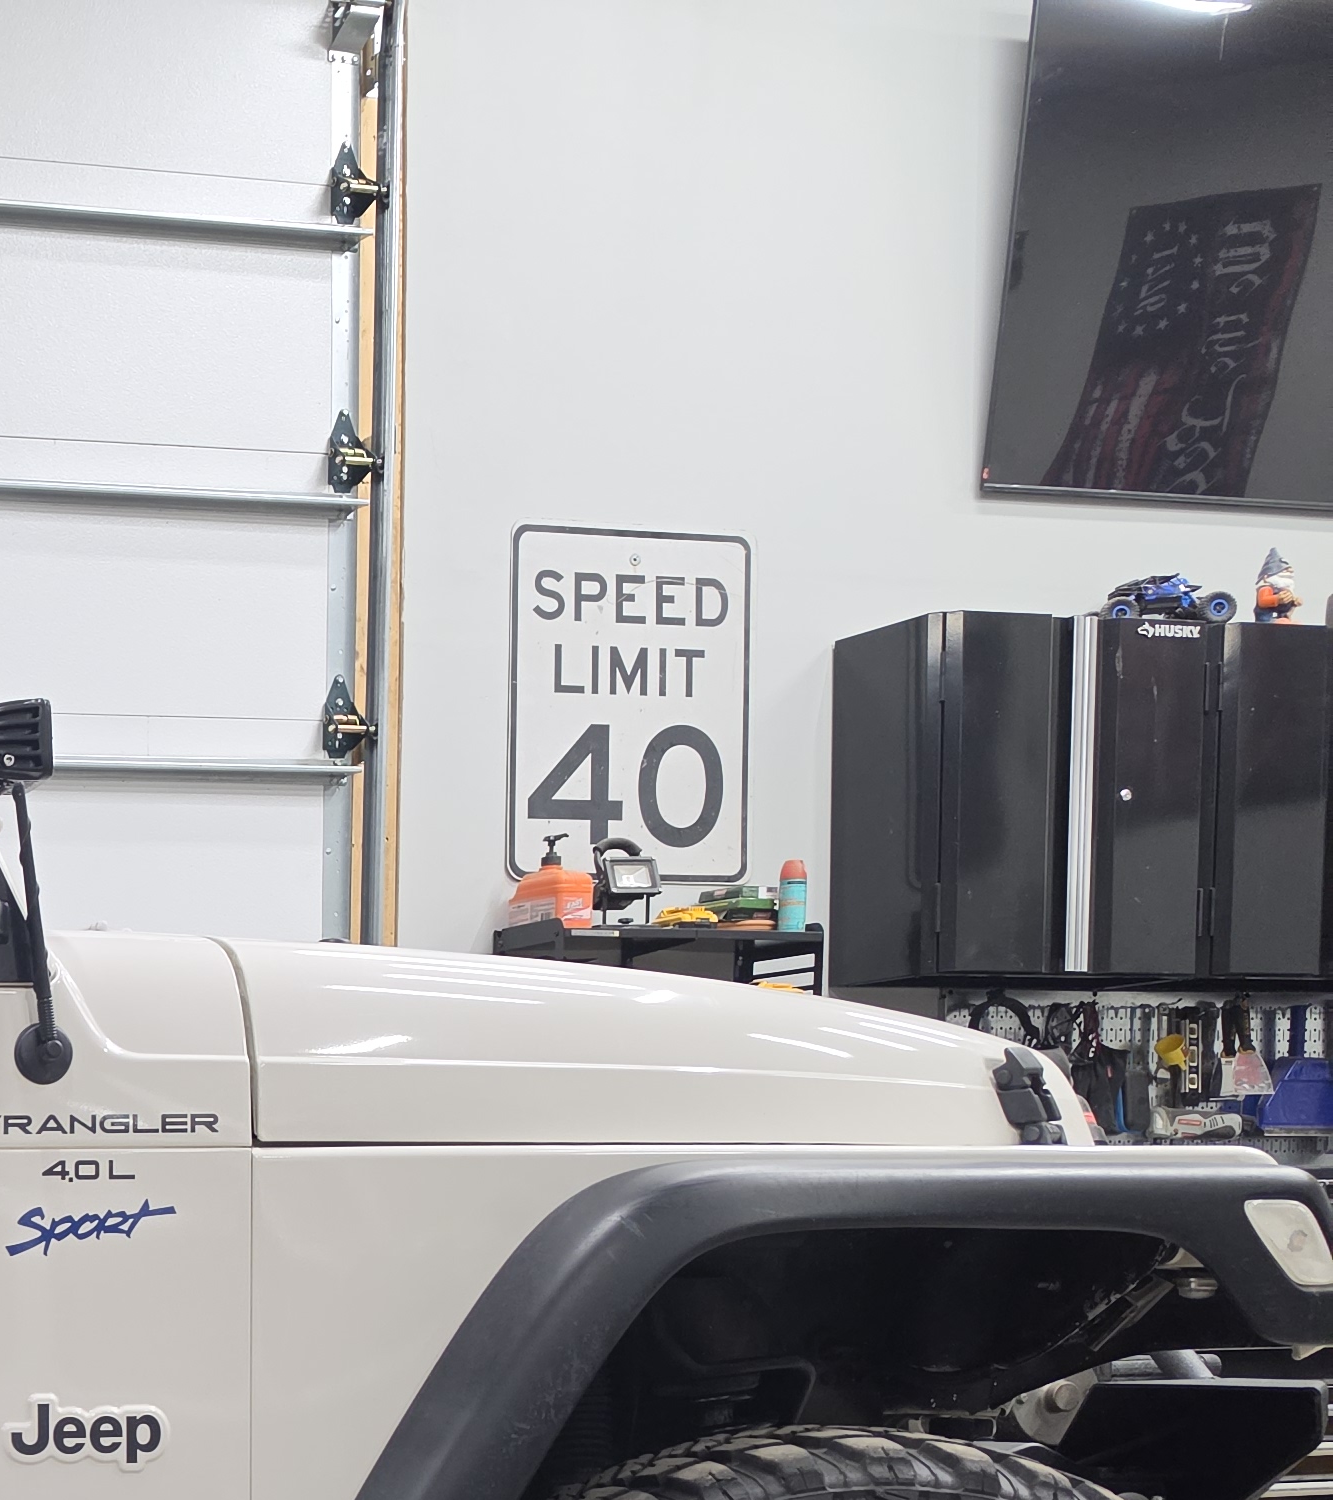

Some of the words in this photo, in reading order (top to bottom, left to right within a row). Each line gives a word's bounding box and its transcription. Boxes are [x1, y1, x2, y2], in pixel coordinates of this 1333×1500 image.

[532, 569, 730, 628] SPEED
[1154, 624, 1201, 638] HUSKY
[553, 643, 706, 698] LIMIT
[527, 723, 724, 848] 40
[11, 1403, 162, 1464] Jeep
